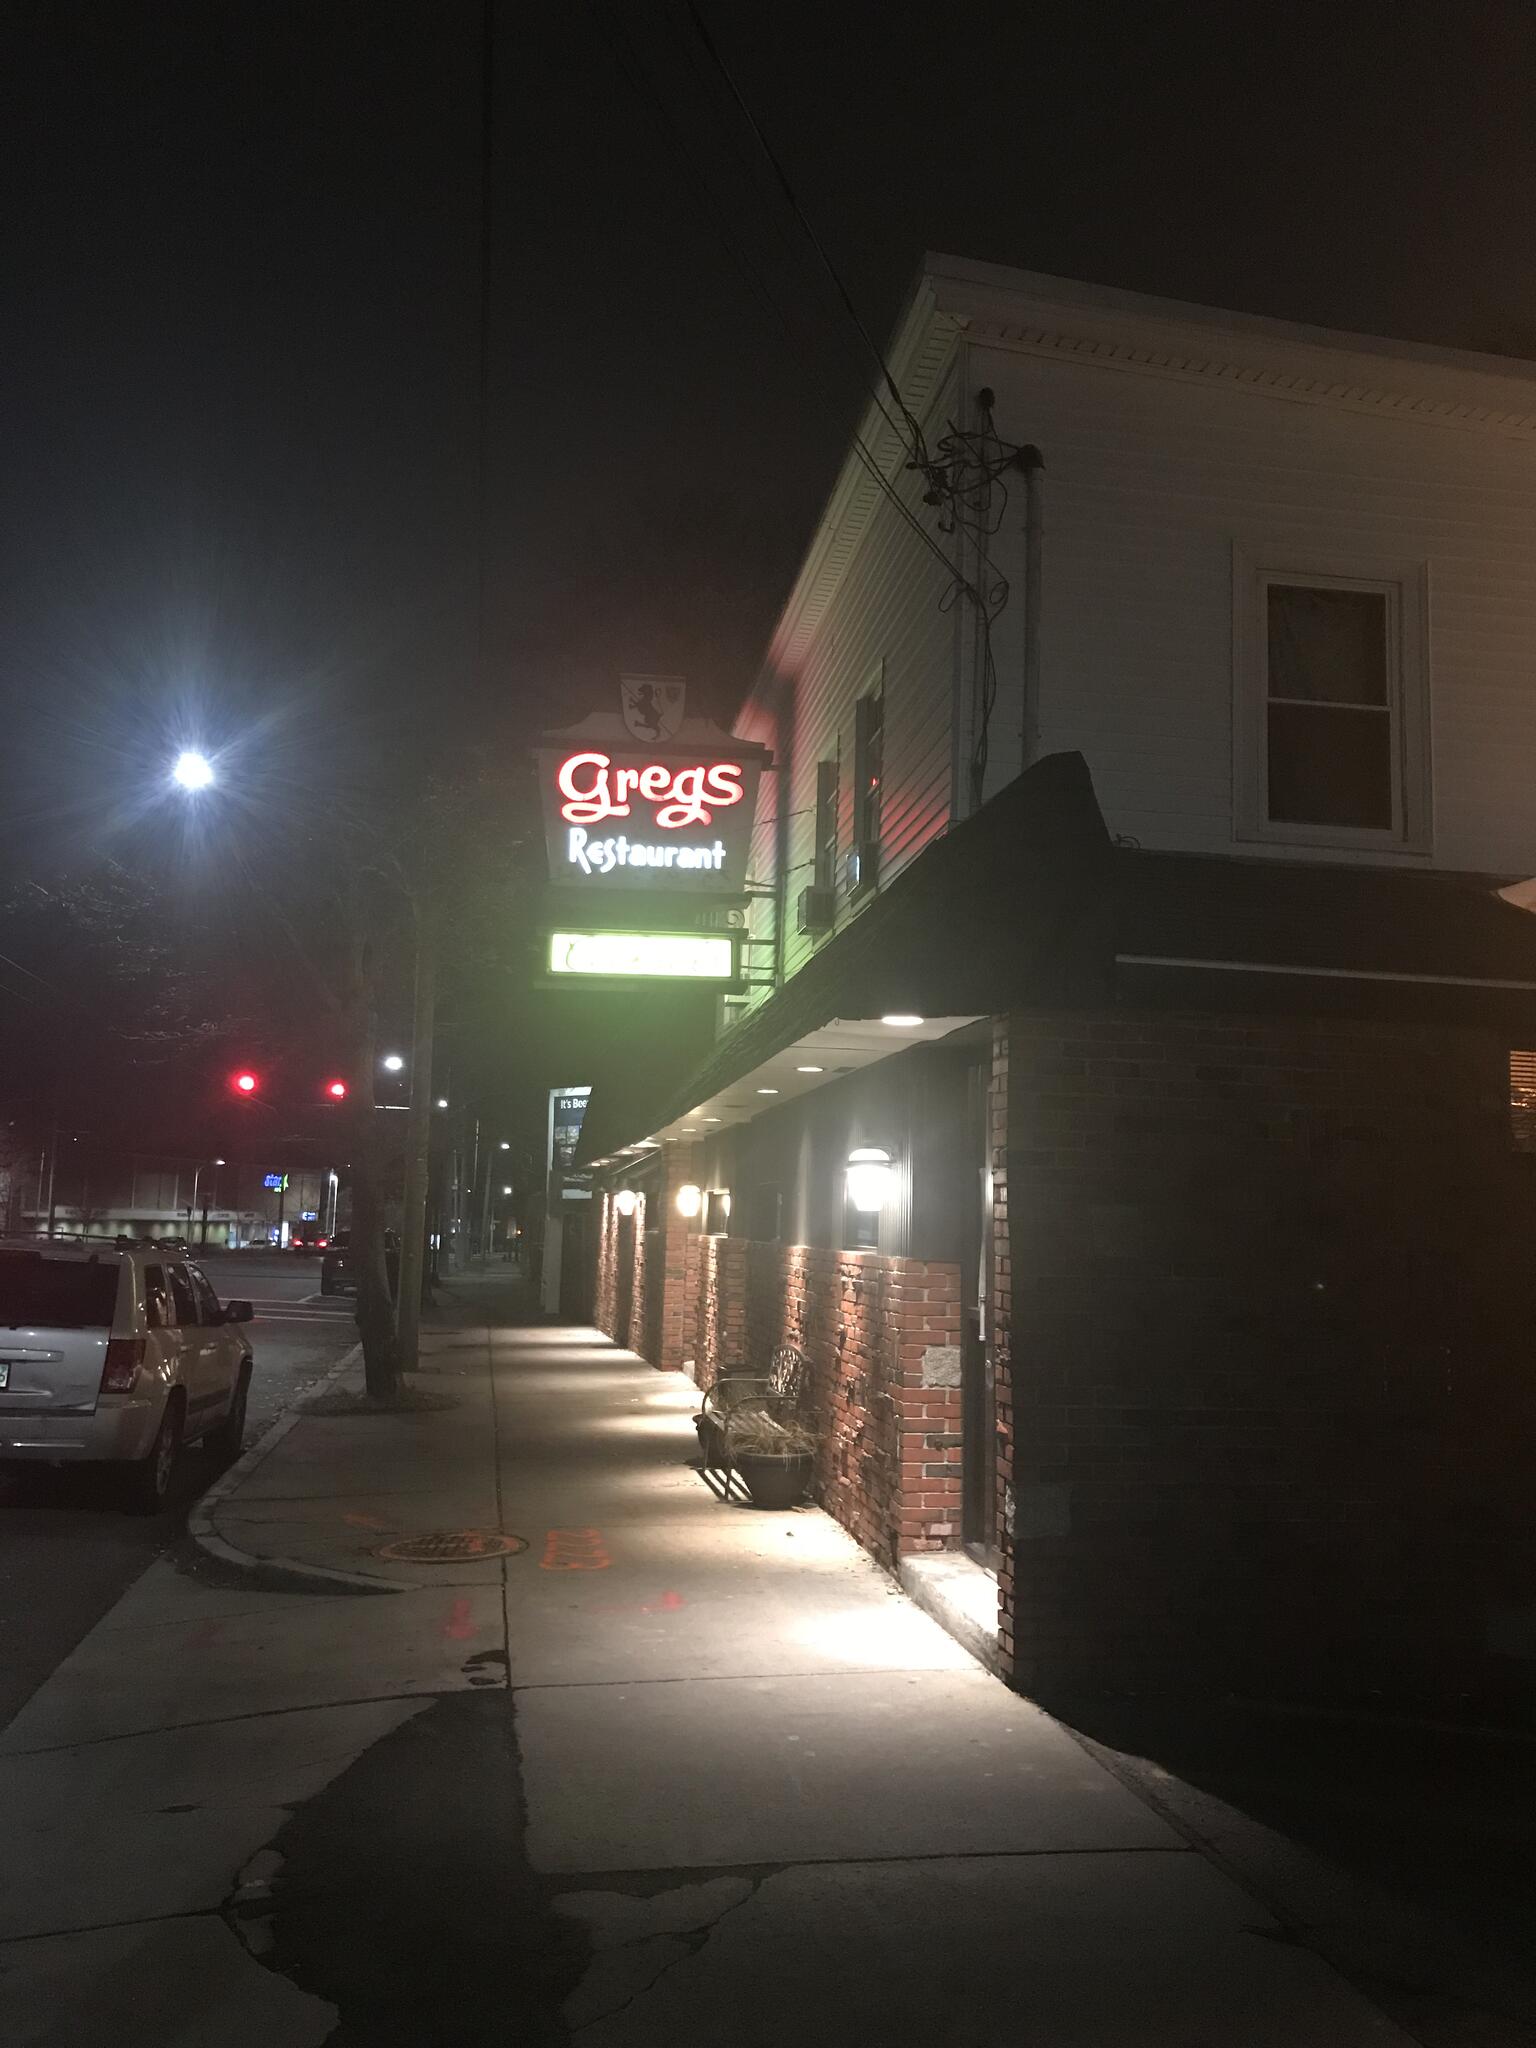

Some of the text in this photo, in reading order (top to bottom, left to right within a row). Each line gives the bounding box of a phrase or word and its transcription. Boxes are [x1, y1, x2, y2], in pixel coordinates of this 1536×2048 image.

[558, 752, 744, 829] Gregs
[568, 827, 727, 875] Restaurant
[560, 1098, 589, 1110] It's Bee
